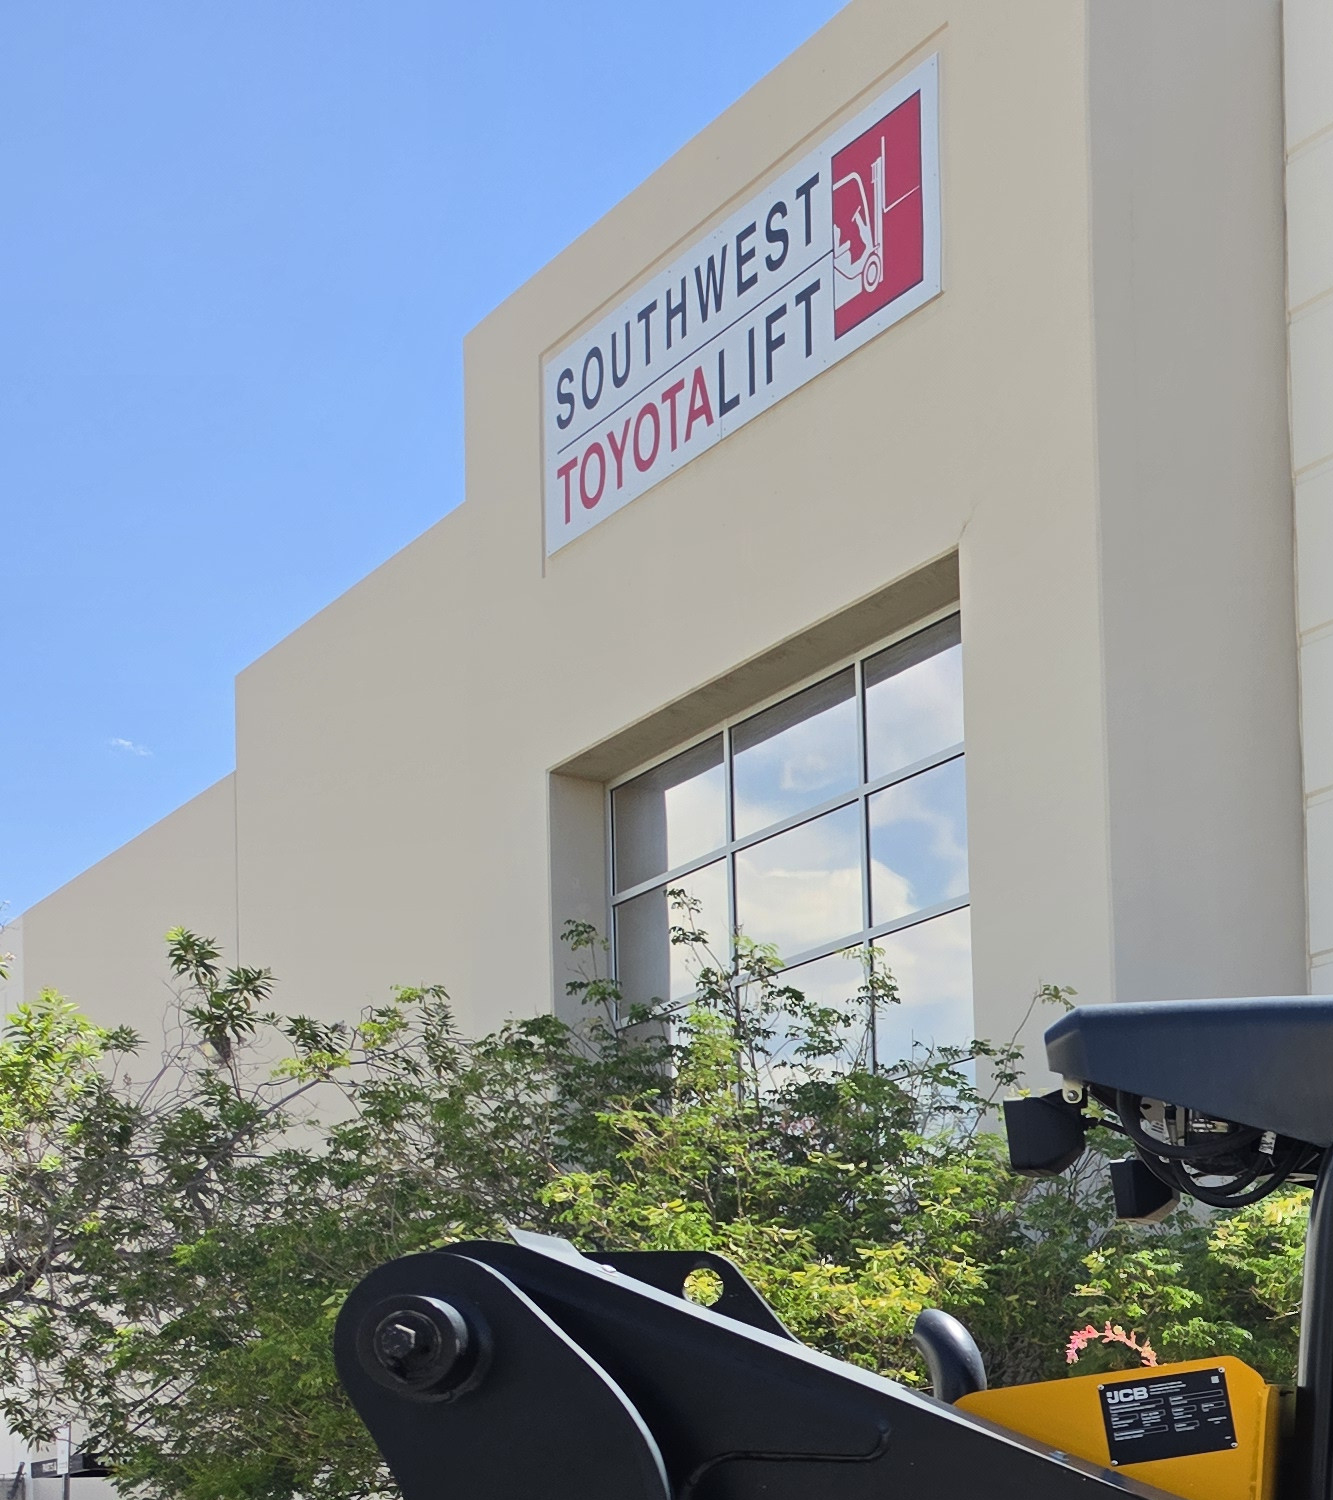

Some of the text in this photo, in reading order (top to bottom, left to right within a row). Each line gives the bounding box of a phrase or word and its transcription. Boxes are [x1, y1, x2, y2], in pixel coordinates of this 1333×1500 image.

[556, 171, 820, 430] SOUTHWEST
[556, 278, 822, 525] TOYOTALIFT
[1106, 1386, 1149, 1404] JCB
